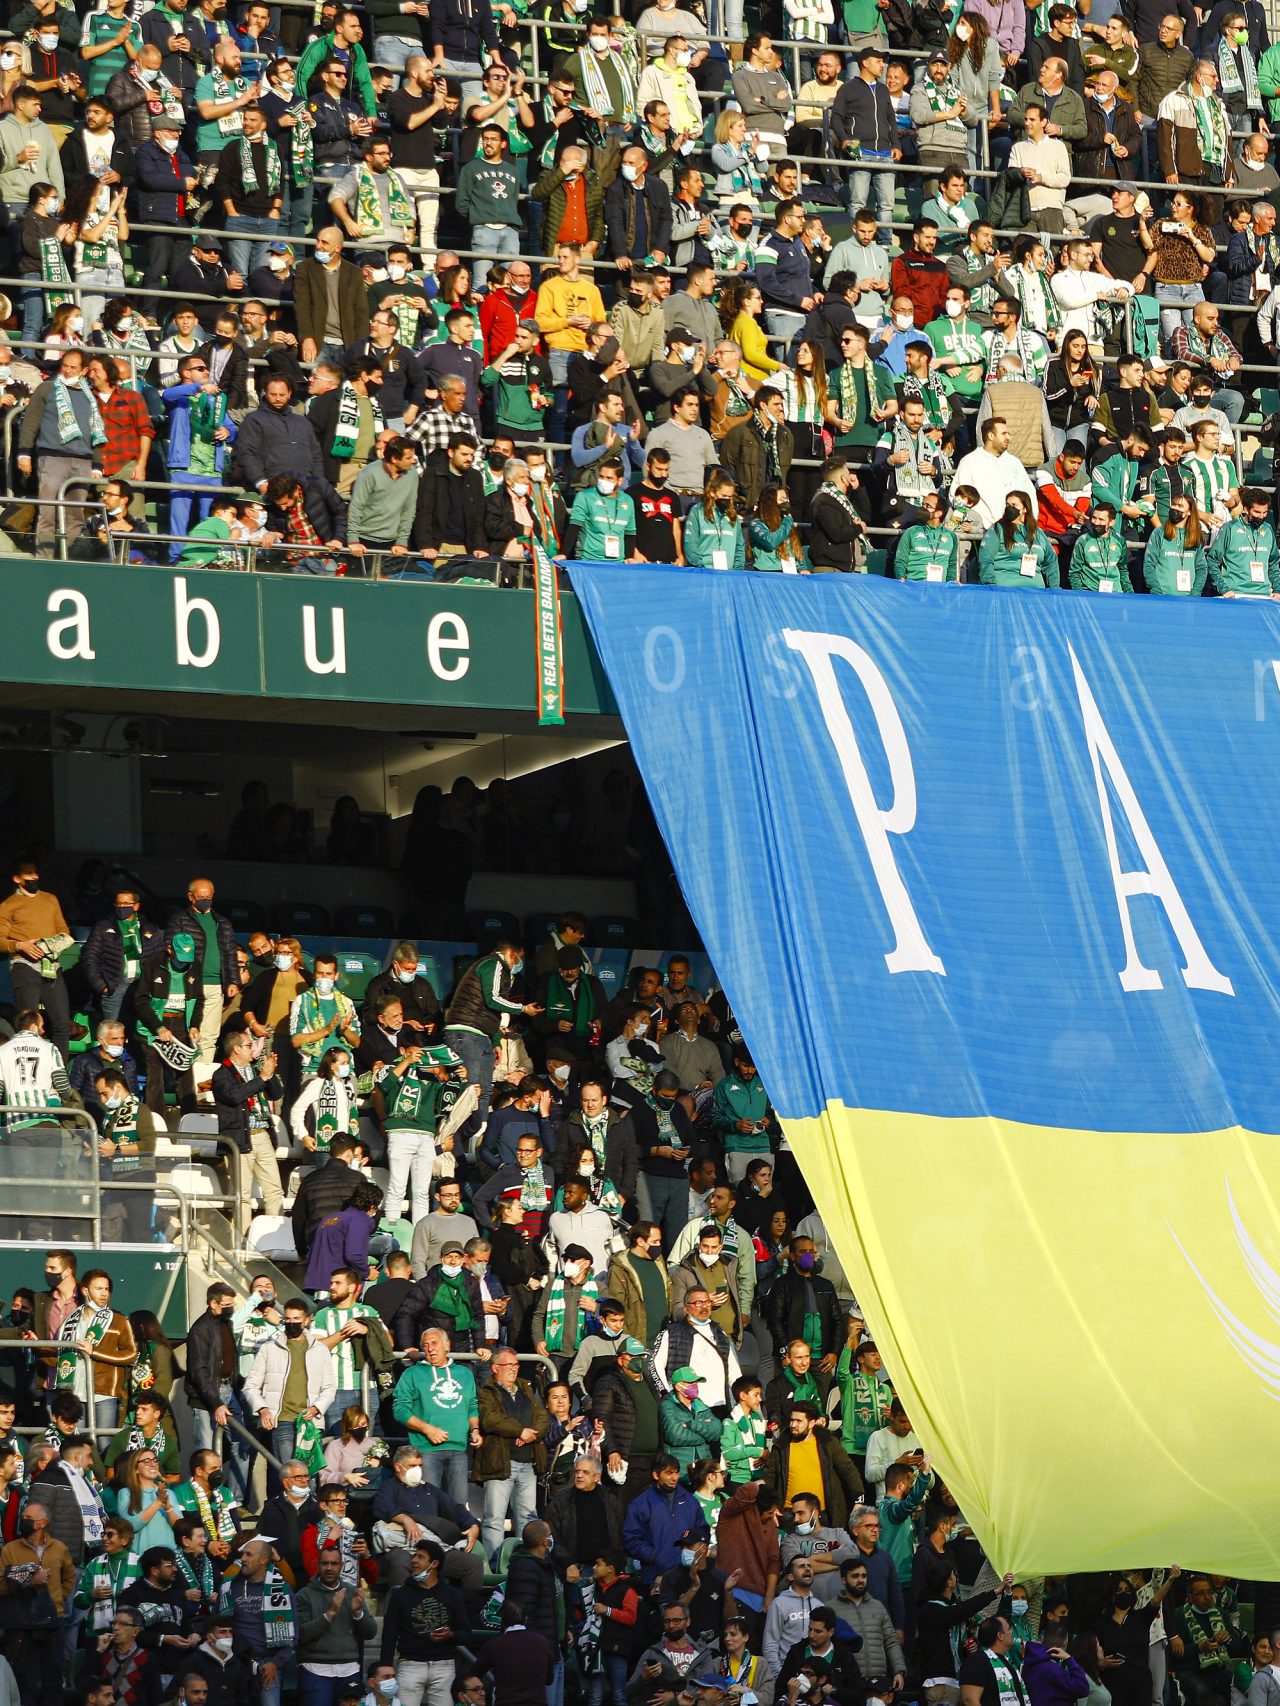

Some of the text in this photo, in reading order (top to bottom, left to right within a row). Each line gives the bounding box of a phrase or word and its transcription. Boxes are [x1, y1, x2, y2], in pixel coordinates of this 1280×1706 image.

[475, 171, 518, 184] HARPER
[541, 611, 555, 652] BETIS
[544, 654, 557, 687] REAL
[13, 1046, 41, 1054] JOAQUIN
[16, 1057, 40, 1085] 17
[154, 1262, 181, 1271] A 127
